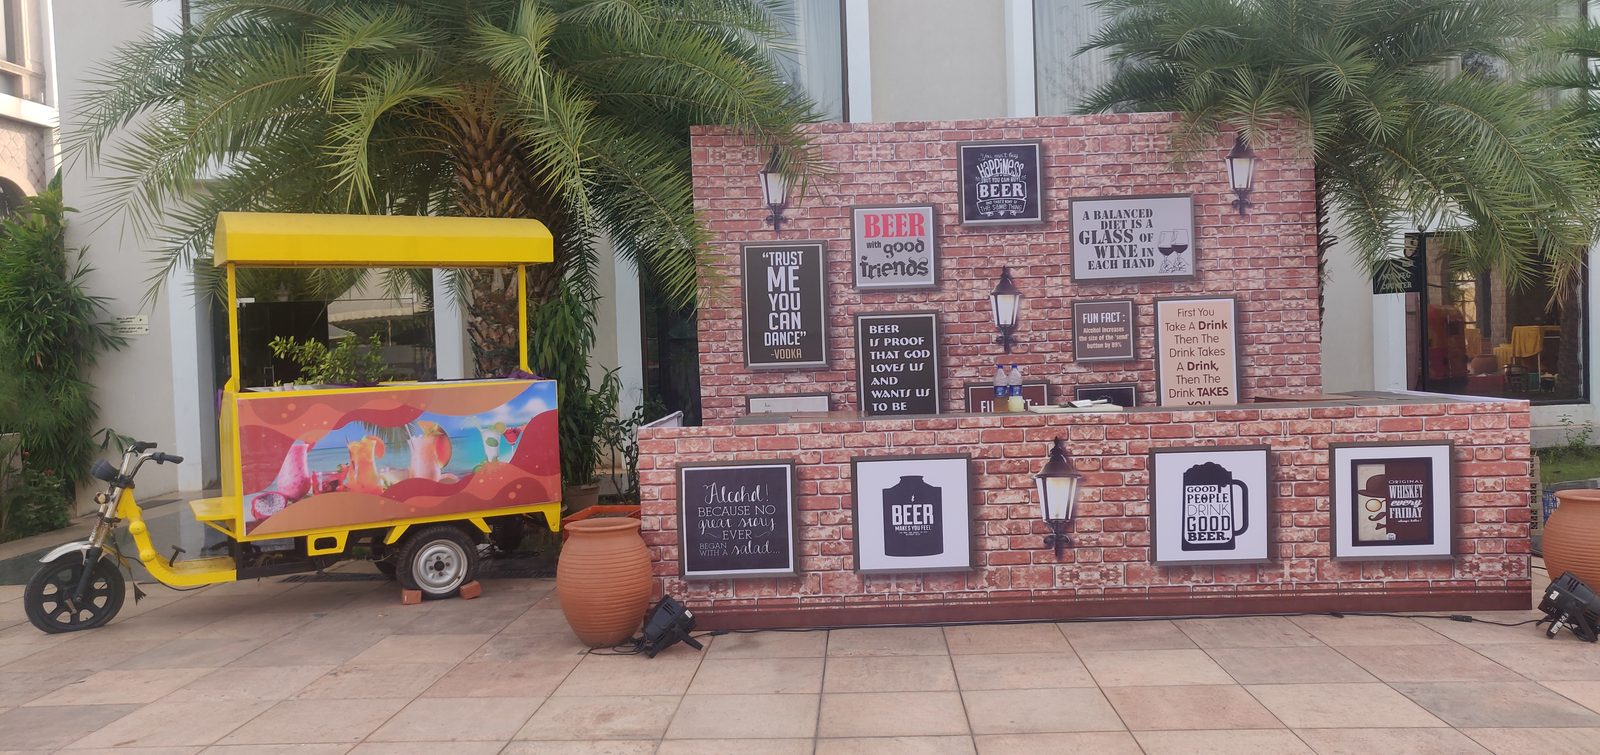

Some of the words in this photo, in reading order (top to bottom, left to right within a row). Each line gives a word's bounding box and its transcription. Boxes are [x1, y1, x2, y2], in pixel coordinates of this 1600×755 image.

[979, 183, 1024, 198] BEER
[1082, 210, 1090, 221] A
[1093, 208, 1154, 220] BALANCED
[863, 212, 925, 239] BEER
[1100, 220, 1128, 230] DIET
[1131, 219, 1143, 229] IS
[1145, 219, 1154, 229] A
[1078, 228, 1135, 246] GLASS
[1139, 232, 1154, 243] OF
[866, 241, 882, 249] with
[882, 237, 925, 259] good
[1094, 244, 1139, 259] WINE
[1141, 247, 1154, 258] IN
[859, 255, 929, 280] friends
[1087, 259, 1119, 271] EACH
[1122, 258, 1155, 270] HAND
[767, 265, 800, 292] ME
[768, 292, 801, 312] YOU
[1082, 312, 1098, 324] FUN
[1100, 312, 1120, 323] FACT
[1177, 308, 1196, 318] First
[1197, 307, 1215, 317] You
[768, 311, 802, 331] CAN
[1165, 322, 1186, 332] Take
[1188, 322, 1196, 331] A
[1198, 320, 1228, 331] Drink
[869, 324, 900, 334] BEER
[869, 338, 880, 347] IS
[883, 336, 925, 347] PROOF
[1174, 334, 1199, 345] Then
[1201, 333, 1220, 344] The
[770, 348, 802, 360] -VODKA
[869, 350, 900, 360] THAT
[904, 349, 931, 359] GOD
[1169, 347, 1195, 358] Drink
[1197, 346, 1226, 357] Takes
[870, 363, 905, 373] LOVES
[909, 362, 925, 372] US
[1176, 362, 1184, 372] A
[1187, 360, 1219, 372] Drink,
[870, 376, 899, 386] AND
[1175, 374, 1200, 385] Then
[1203, 374, 1221, 384] The
[871, 389, 911, 399] WANTS
[915, 388, 931, 397] US
[1168, 388, 1195, 399] Drink
[1197, 386, 1229, 397] TAKES
[871, 402, 888, 412] TO
[891, 401, 908, 411] BE
[1187, 485, 1217, 493] GOOD
[1388, 484, 1424, 499] WHISKEY
[1187, 493, 1230, 504] PEOPLE
[1390, 499, 1424, 508] every
[698, 505, 751, 518] BECAUSE
[755, 504, 776, 515] NO
[892, 504, 934, 526] BEER
[1187, 503, 1231, 517] DRINK
[1389, 507, 1424, 519] FRIDAY
[698, 519, 733, 535] great
[738, 518, 776, 531] story
[1187, 515, 1231, 532] GOOD
[722, 529, 753, 541] EVER
[1187, 531, 1231, 542] BEER.
[700, 542, 728, 550] BEGAN
[700, 549, 721, 557] WITH
